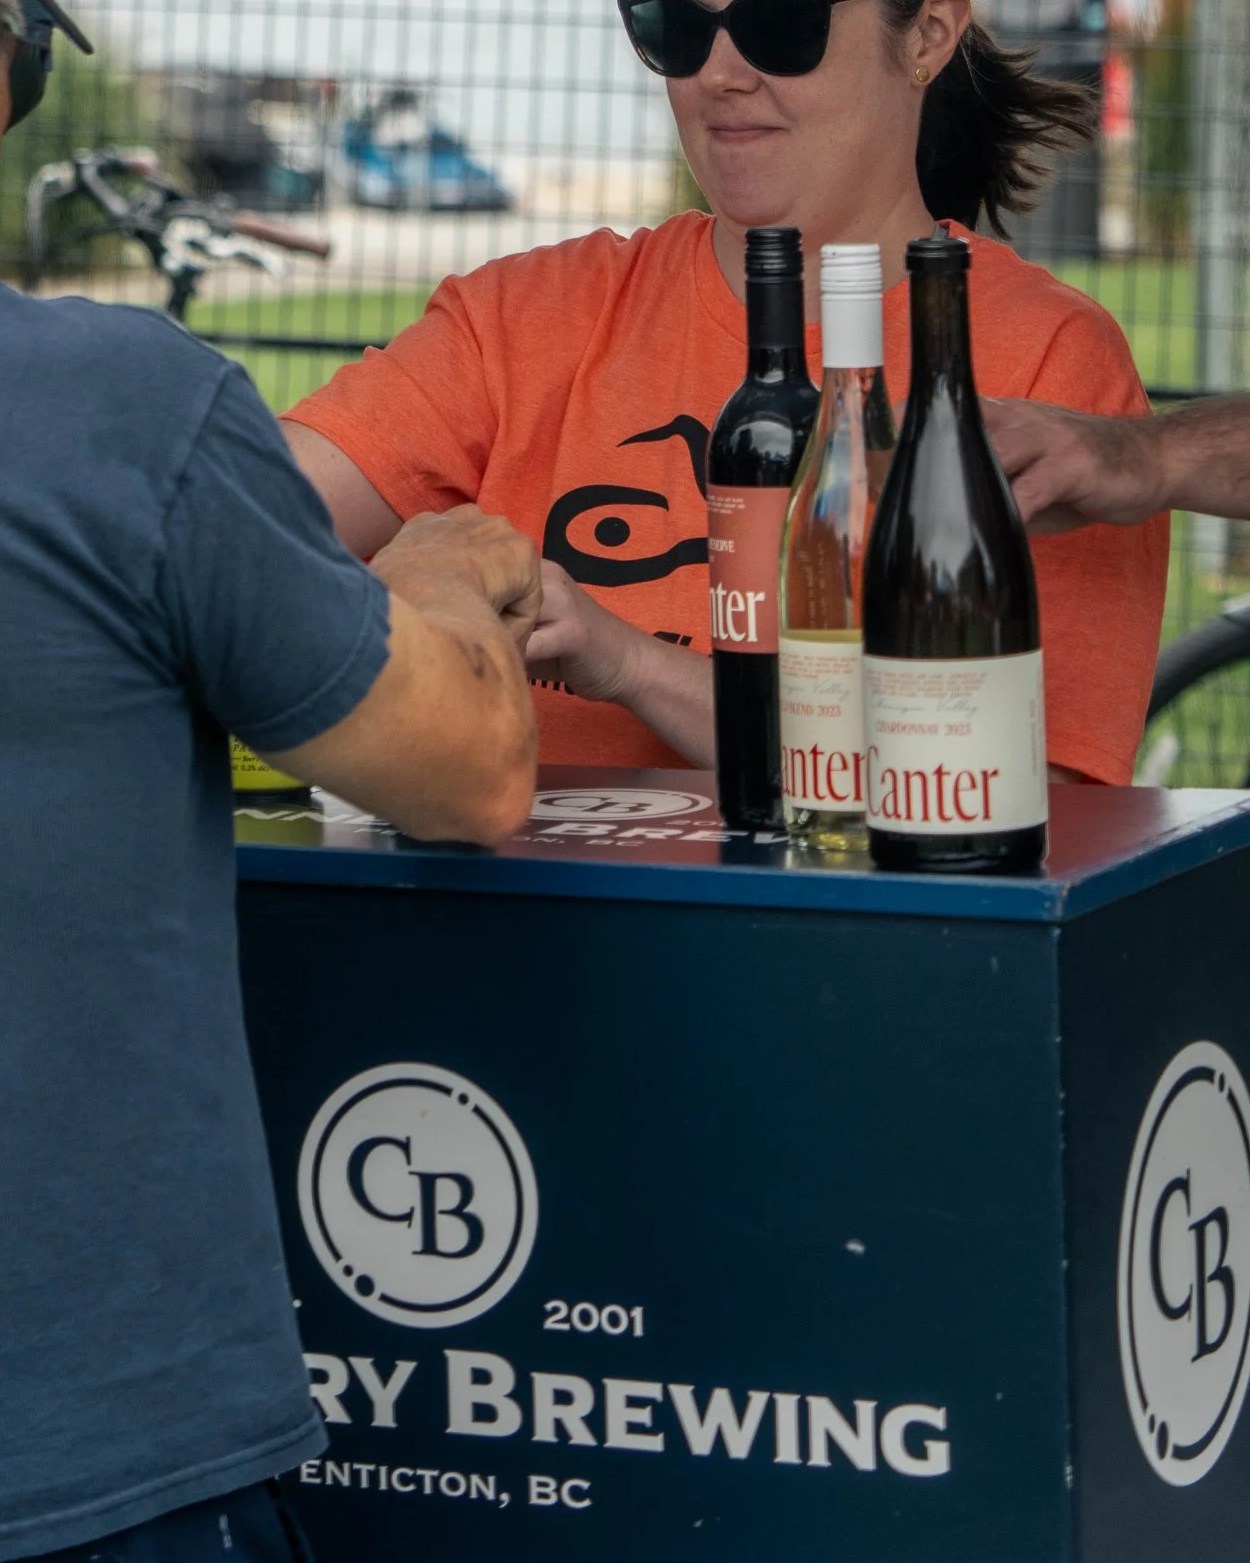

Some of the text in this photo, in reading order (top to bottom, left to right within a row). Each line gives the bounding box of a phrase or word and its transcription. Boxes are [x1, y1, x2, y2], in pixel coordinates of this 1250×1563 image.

[866, 743, 999, 822] Canter
[347, 1135, 486, 1259] CB
[1150, 1169, 1236, 1365] CB
[542, 1299, 646, 1339] 2001
[444, 1348, 950, 1478] BREWING
[298, 1456, 593, 1510] ENTICTON, BC
